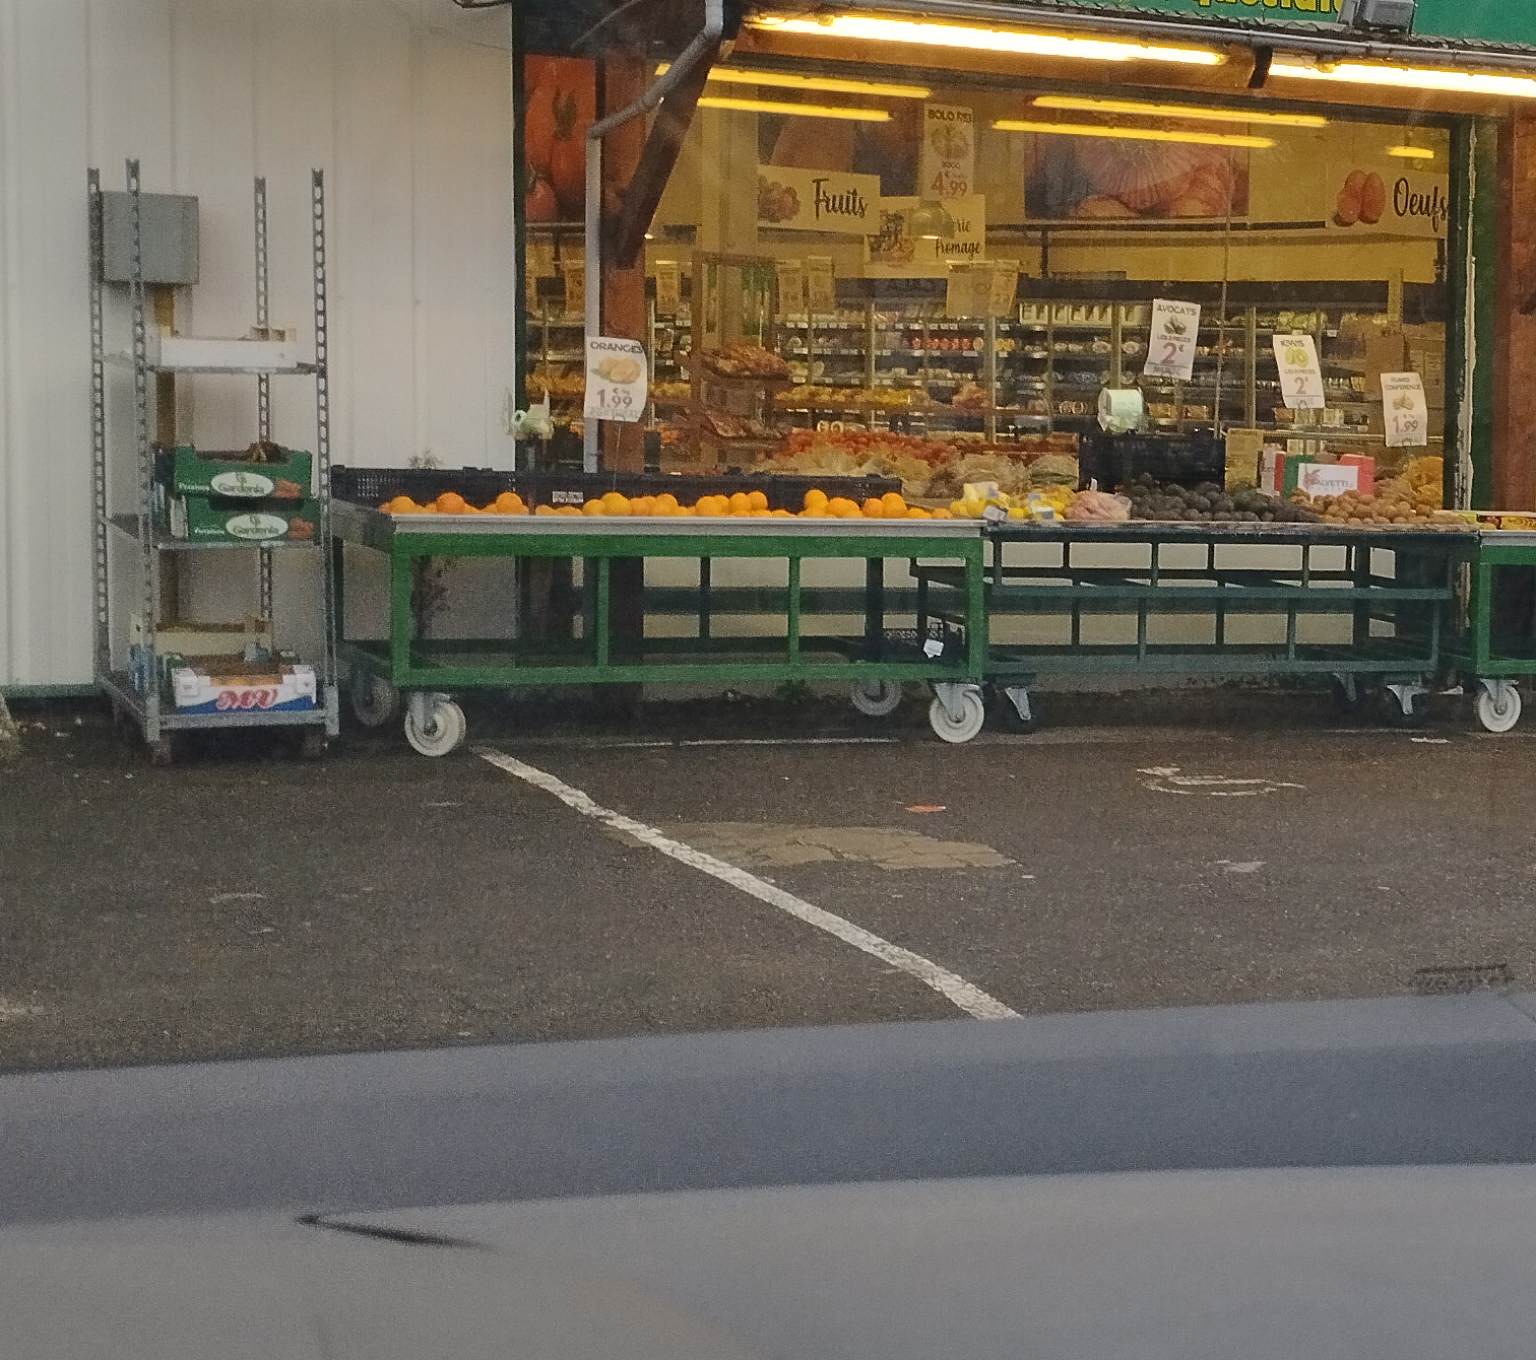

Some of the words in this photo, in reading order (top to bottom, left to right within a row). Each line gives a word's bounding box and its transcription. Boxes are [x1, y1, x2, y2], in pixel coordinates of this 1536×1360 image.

[812, 177, 868, 221] Fruits
[1393, 177, 1447, 233] Oeufs
[1156, 304, 1197, 317] AVOCATS
[589, 340, 643, 354] ORANGES
[1161, 341, 1178, 365] 2
[1293, 376, 1307, 395] 2
[596, 388, 633, 409] 1.99
